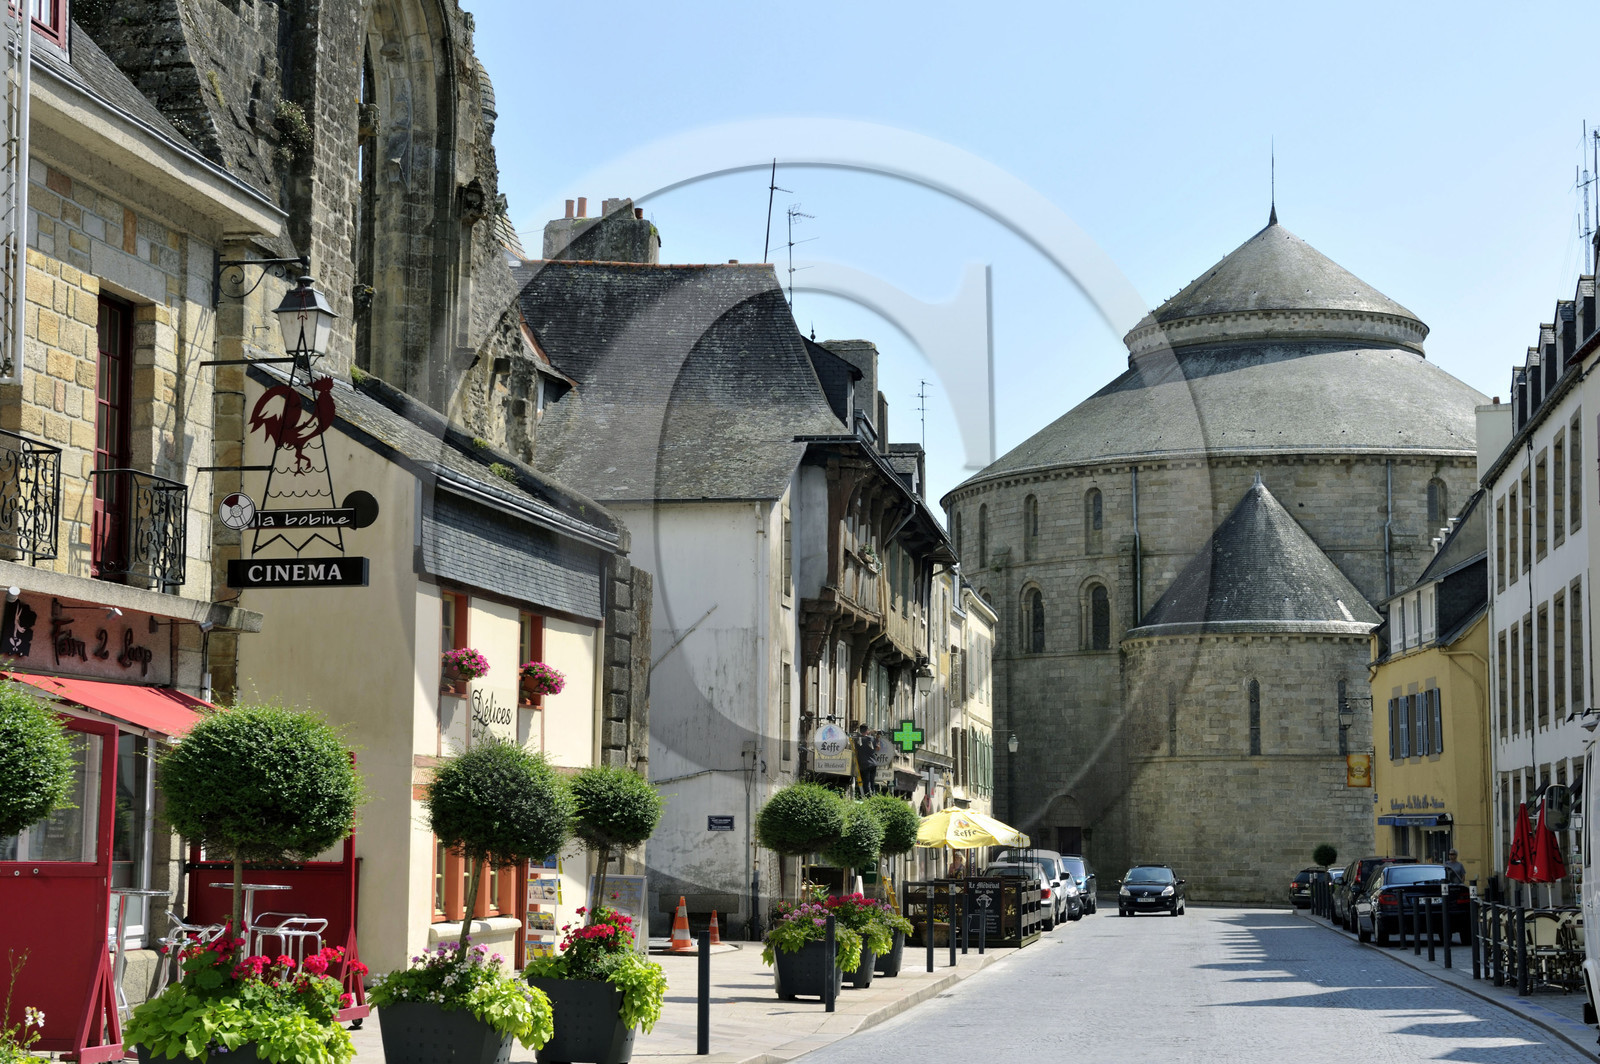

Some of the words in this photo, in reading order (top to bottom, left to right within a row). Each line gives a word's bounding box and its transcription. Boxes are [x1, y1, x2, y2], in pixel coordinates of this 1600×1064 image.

[258, 512, 275, 526] la
[285, 511, 350, 526] bobine
[248, 564, 342, 582] CINEMA
[93, 629, 109, 660] 2
[472, 688, 513, 727] Délices
[820, 742, 839, 753] Leffe
[954, 829, 977, 838] Leffe
